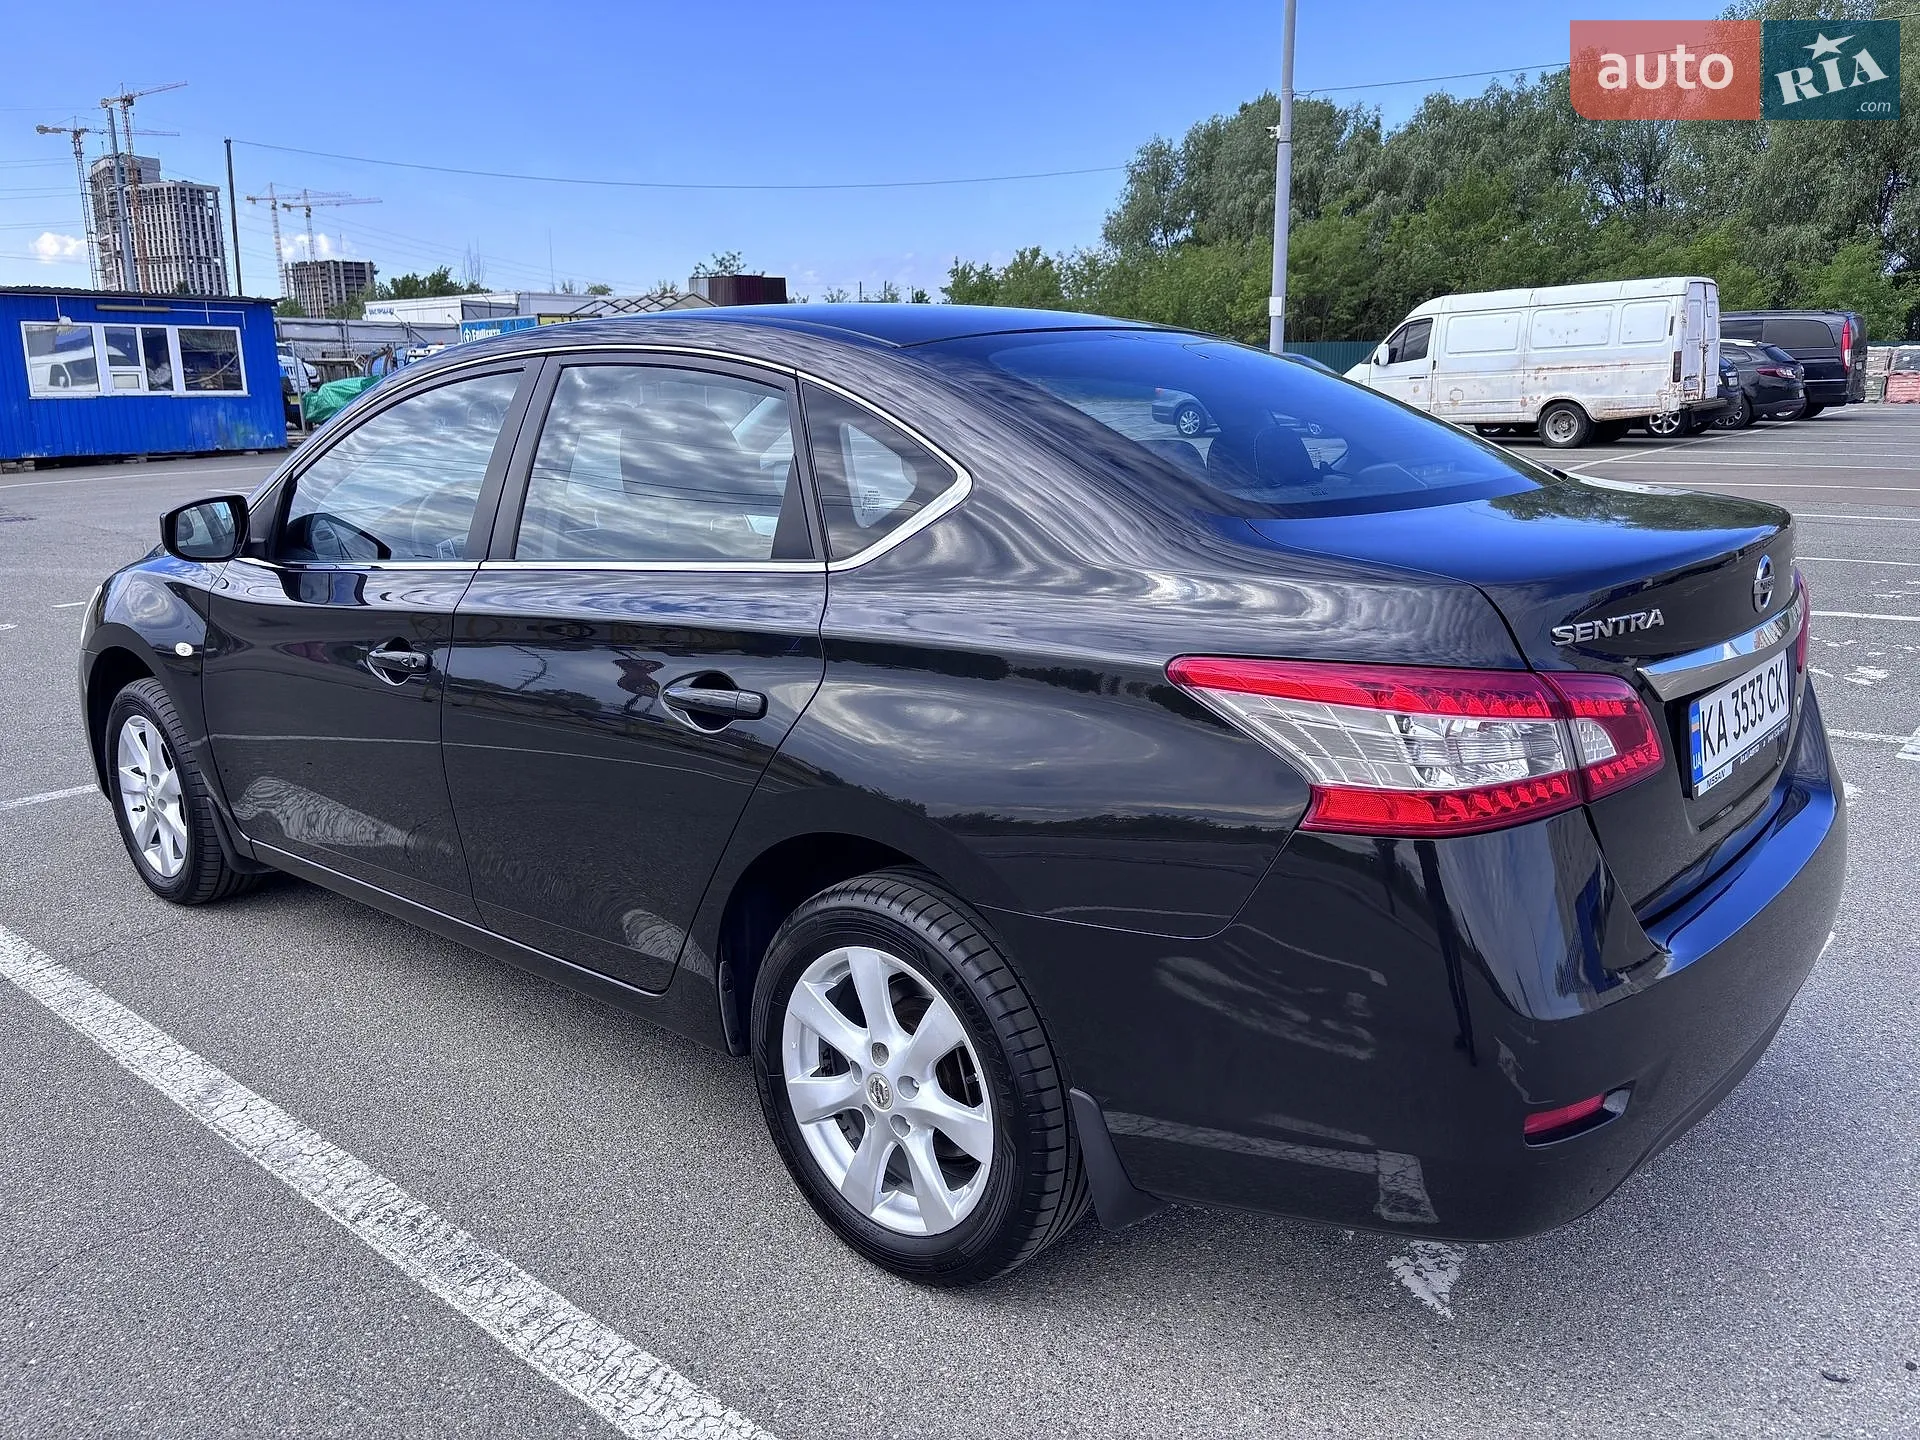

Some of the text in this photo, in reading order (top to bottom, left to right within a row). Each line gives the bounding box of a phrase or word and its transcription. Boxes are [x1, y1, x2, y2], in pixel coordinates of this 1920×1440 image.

[1551, 608, 1665, 647] SENTRA
[1701, 699, 1729, 762] KA
[1731, 672, 1765, 741] 3533
[1767, 659, 1785, 714] CK
[1692, 751, 1702, 771] UA
[1706, 768, 1726, 789] NISSAN
